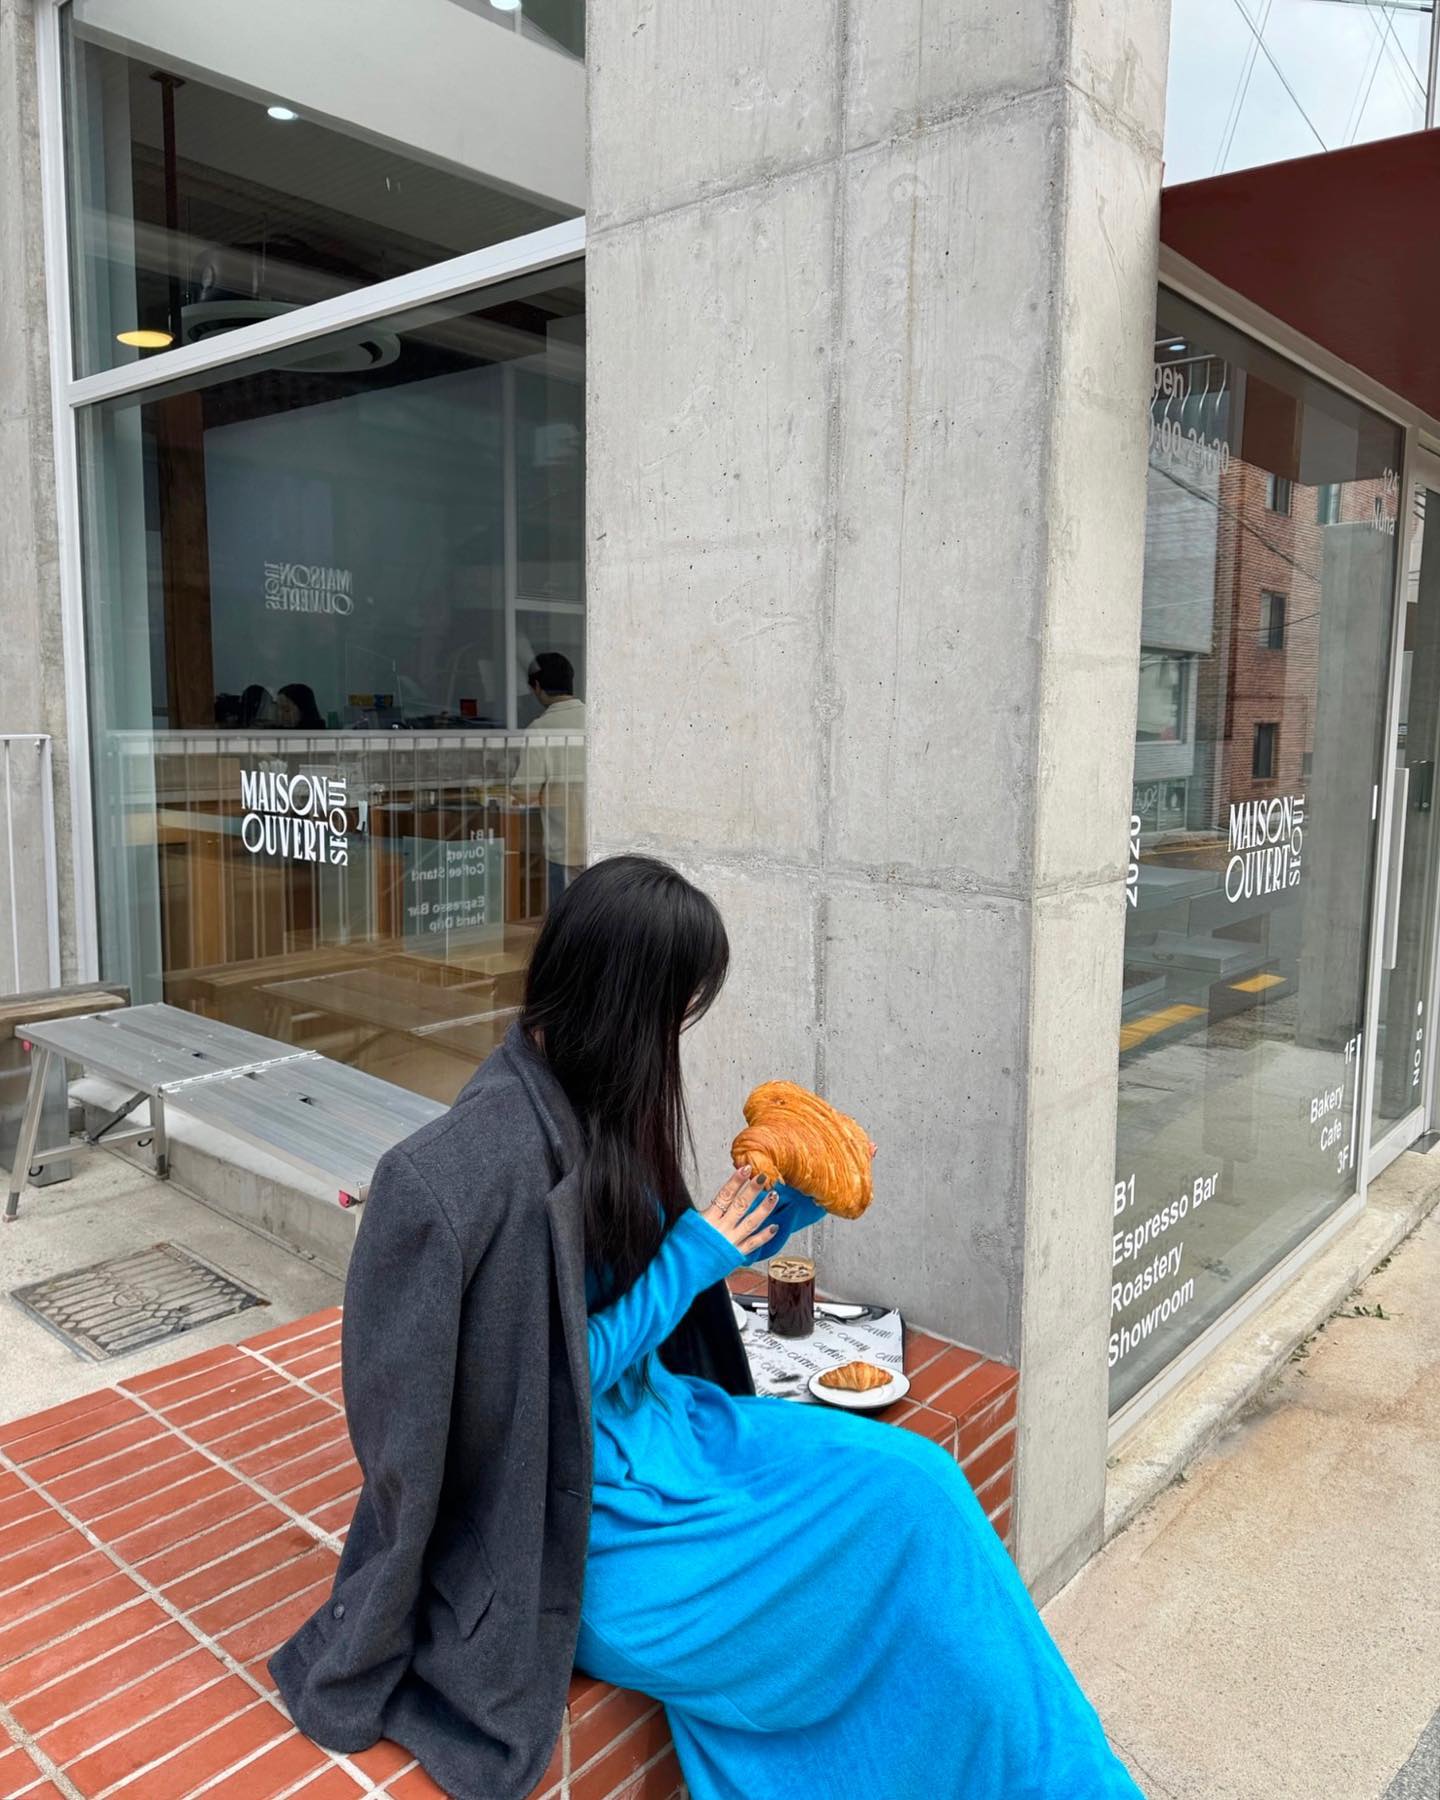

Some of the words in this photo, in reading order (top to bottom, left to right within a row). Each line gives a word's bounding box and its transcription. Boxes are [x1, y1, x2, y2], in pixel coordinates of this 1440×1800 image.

[1152, 364, 1184, 401] pen
[240, 769, 328, 818] MAISON
[241, 813, 328, 863] OUVERT
[328, 778, 348, 866] SEOUL
[1228, 796, 1293, 852] MAISON
[1289, 794, 1305, 886] SEOUL
[1225, 844, 1290, 903] OUVERT
[1344, 1038, 1355, 1064] 1F
[1310, 1084, 1344, 1123] Bakery
[1320, 1118, 1342, 1151] Cafe
[1337, 1144, 1349, 1174] 3F
[1112, 1195, 1188, 1267] Espresso
[1192, 1172, 1218, 1209] Bar
[1113, 1173, 1135, 1216] B1
[1110, 1242, 1184, 1318] Roastery
[1108, 1278, 1194, 1368] Showroom
